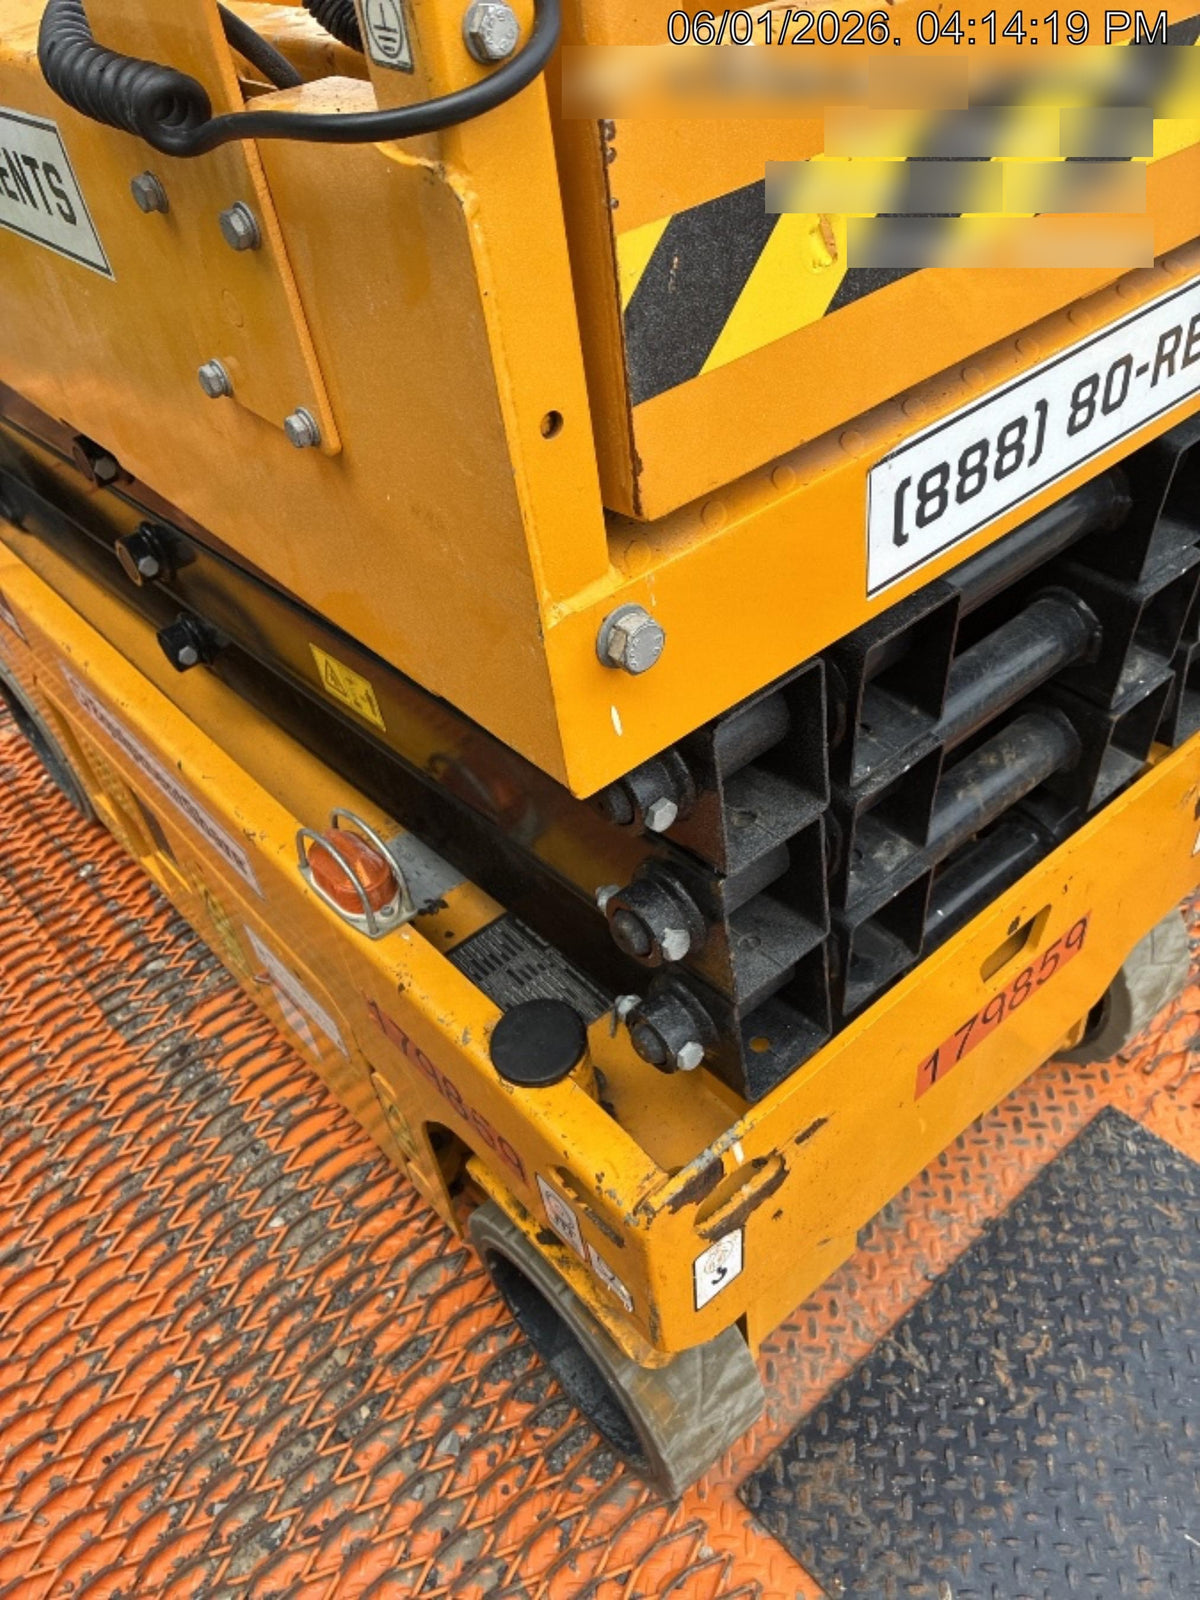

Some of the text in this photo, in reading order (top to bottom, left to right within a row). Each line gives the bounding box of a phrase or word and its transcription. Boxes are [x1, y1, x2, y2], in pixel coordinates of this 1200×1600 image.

[0, 147, 77, 226] ENTS
[892, 398, 1049, 547] (888)
[923, 915, 1089, 1084] 179859
